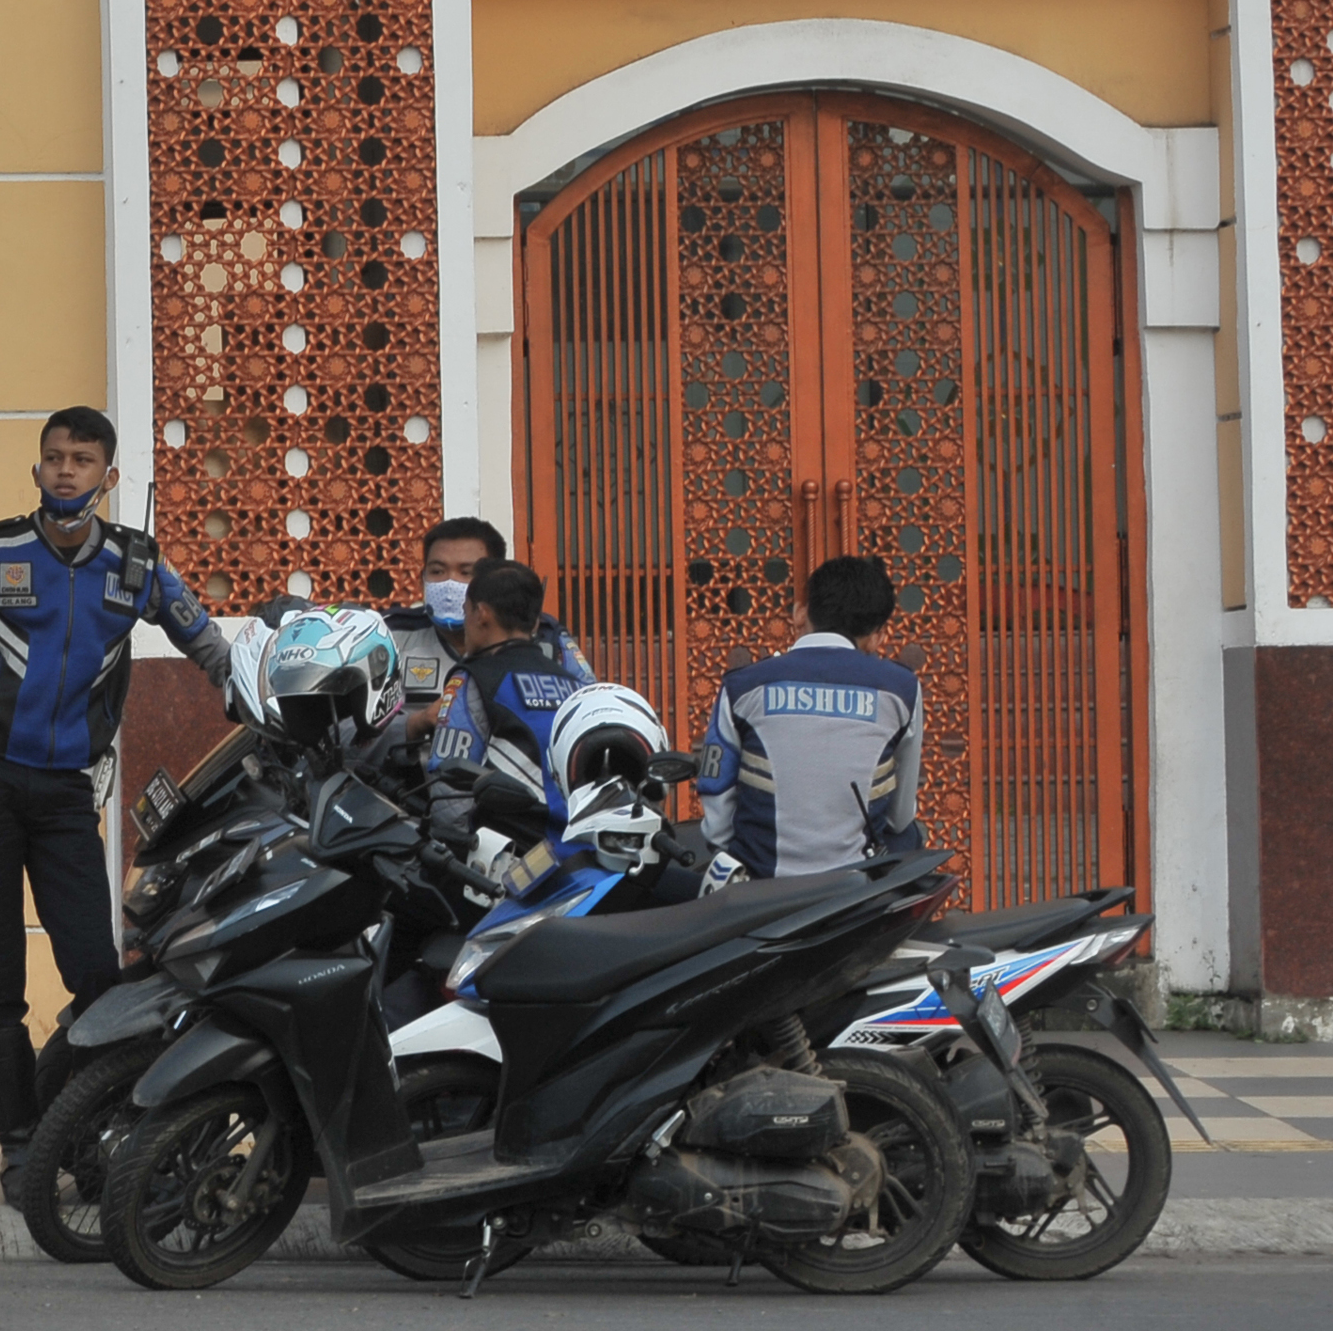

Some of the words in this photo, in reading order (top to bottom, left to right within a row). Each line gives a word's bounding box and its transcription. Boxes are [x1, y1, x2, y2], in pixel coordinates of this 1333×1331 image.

[525, 698, 552, 707] KOTA
[767, 686, 874, 717] DISHUB
[298, 964, 345, 985] HONDA
